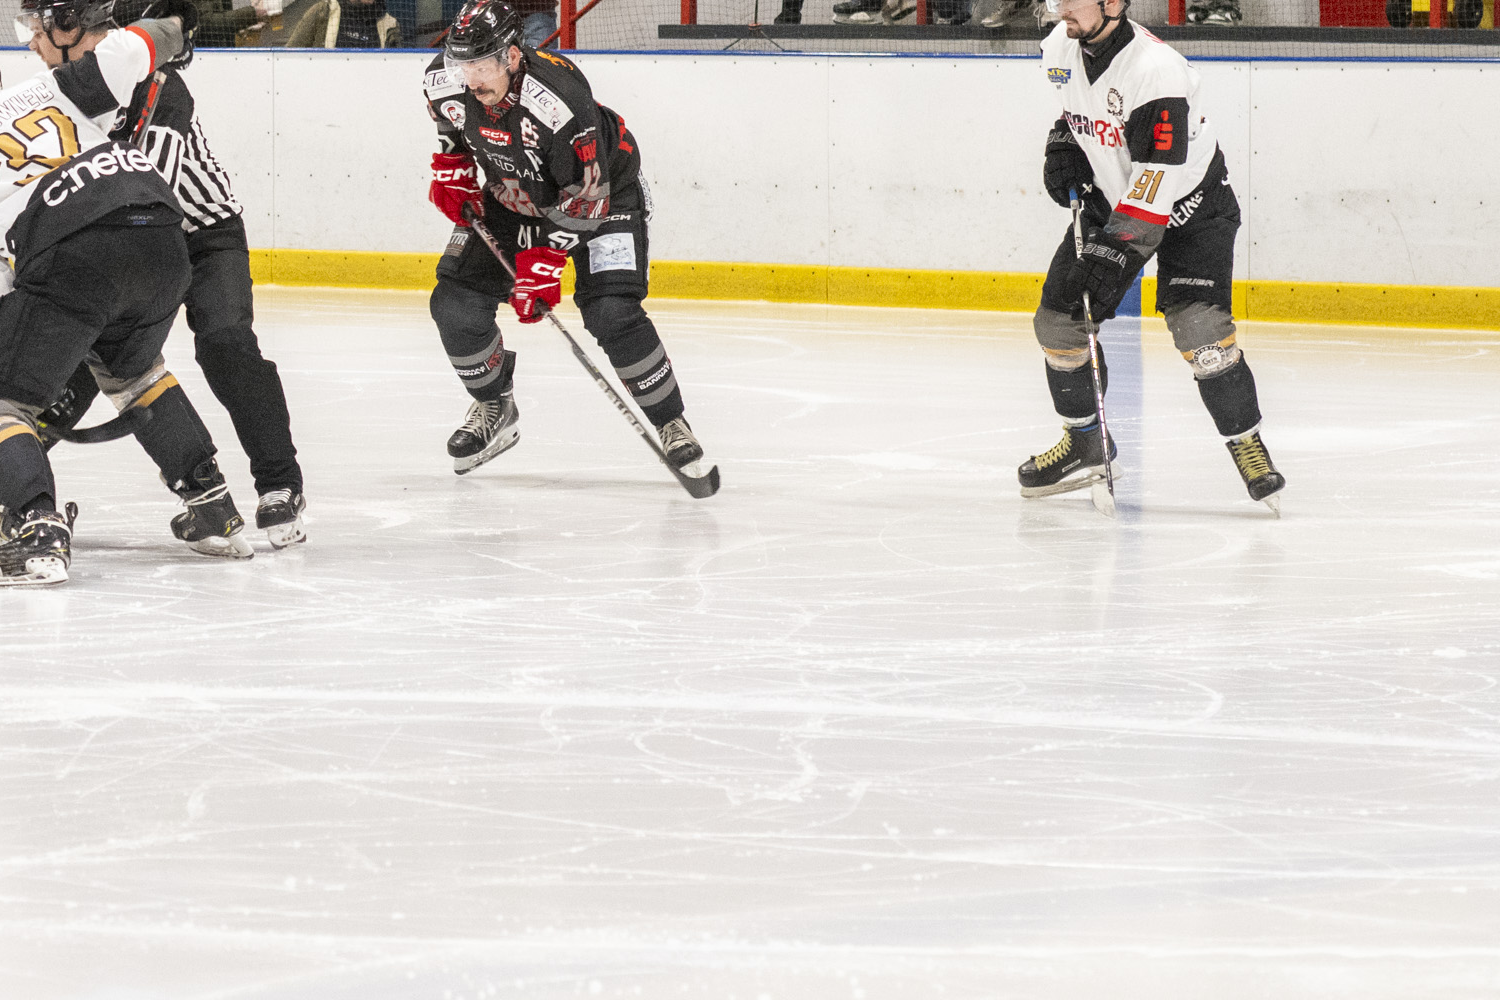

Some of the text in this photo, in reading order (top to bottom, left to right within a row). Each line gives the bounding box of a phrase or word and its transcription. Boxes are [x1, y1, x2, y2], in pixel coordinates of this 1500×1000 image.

[522, 77, 558, 109] SiTec
[481, 129, 510, 142] CCM
[579, 161, 601, 197] 12
[1127, 169, 1165, 204] 91
[1169, 278, 1215, 287] BAUER
[639, 365, 671, 390] BANNAT
